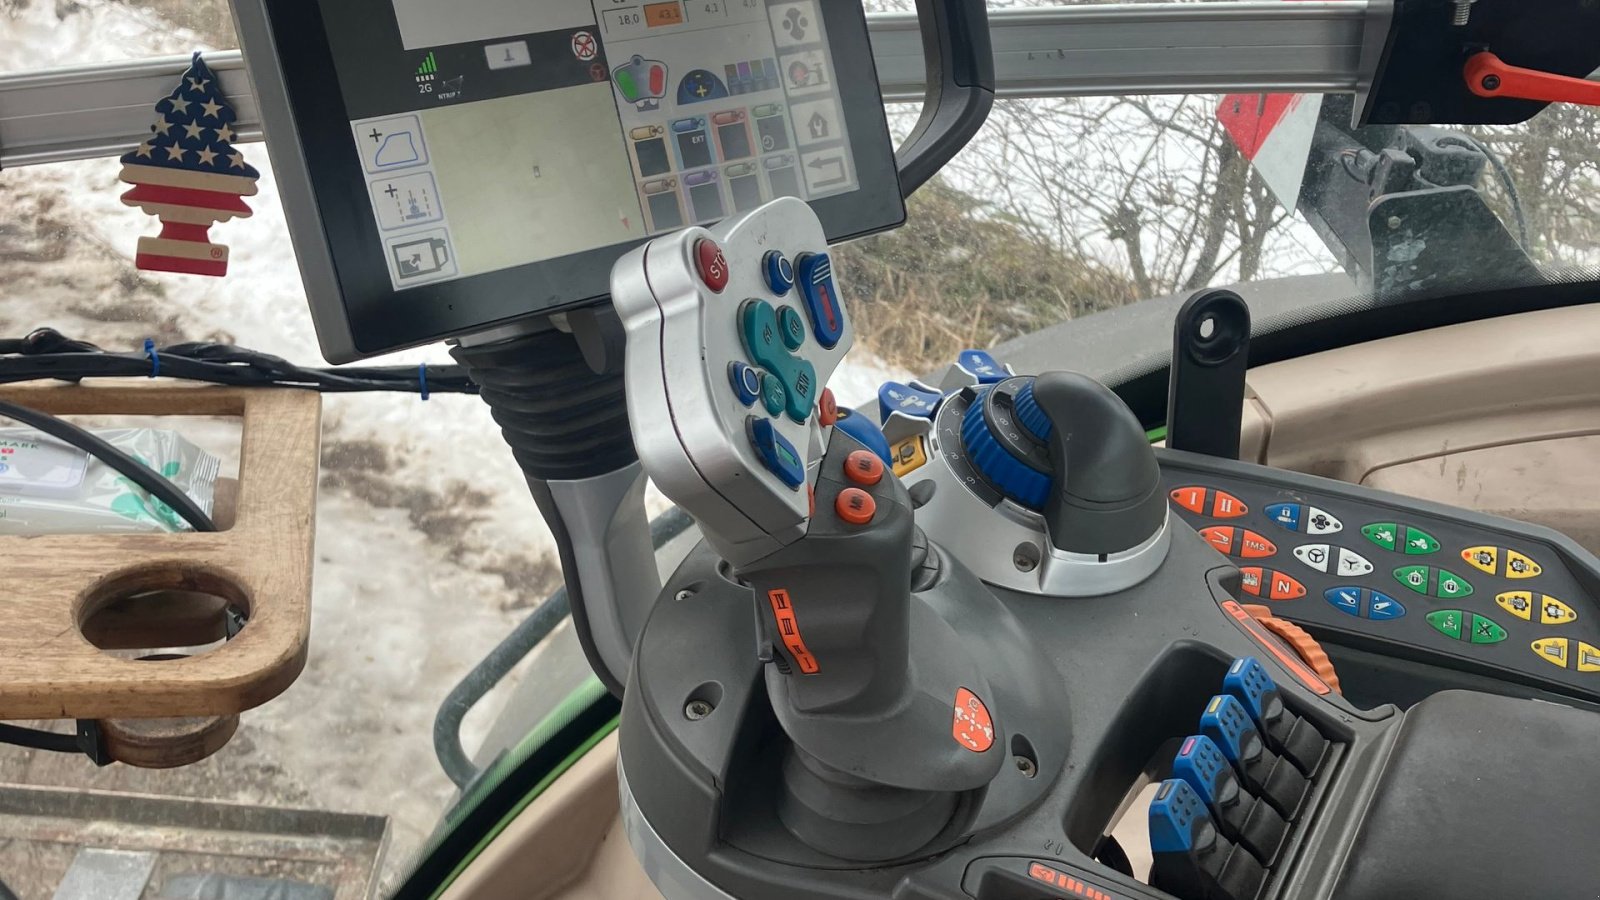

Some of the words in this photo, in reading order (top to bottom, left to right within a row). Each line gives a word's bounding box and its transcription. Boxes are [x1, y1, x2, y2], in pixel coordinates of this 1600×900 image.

[618, 14, 640, 26] 18,0
[418, 83, 433, 94] 2G
[691, 135, 704, 144] EXT
[1244, 540, 1265, 551] TMS
[1278, 581, 1291, 593] N
[781, 618, 794, 636] III
